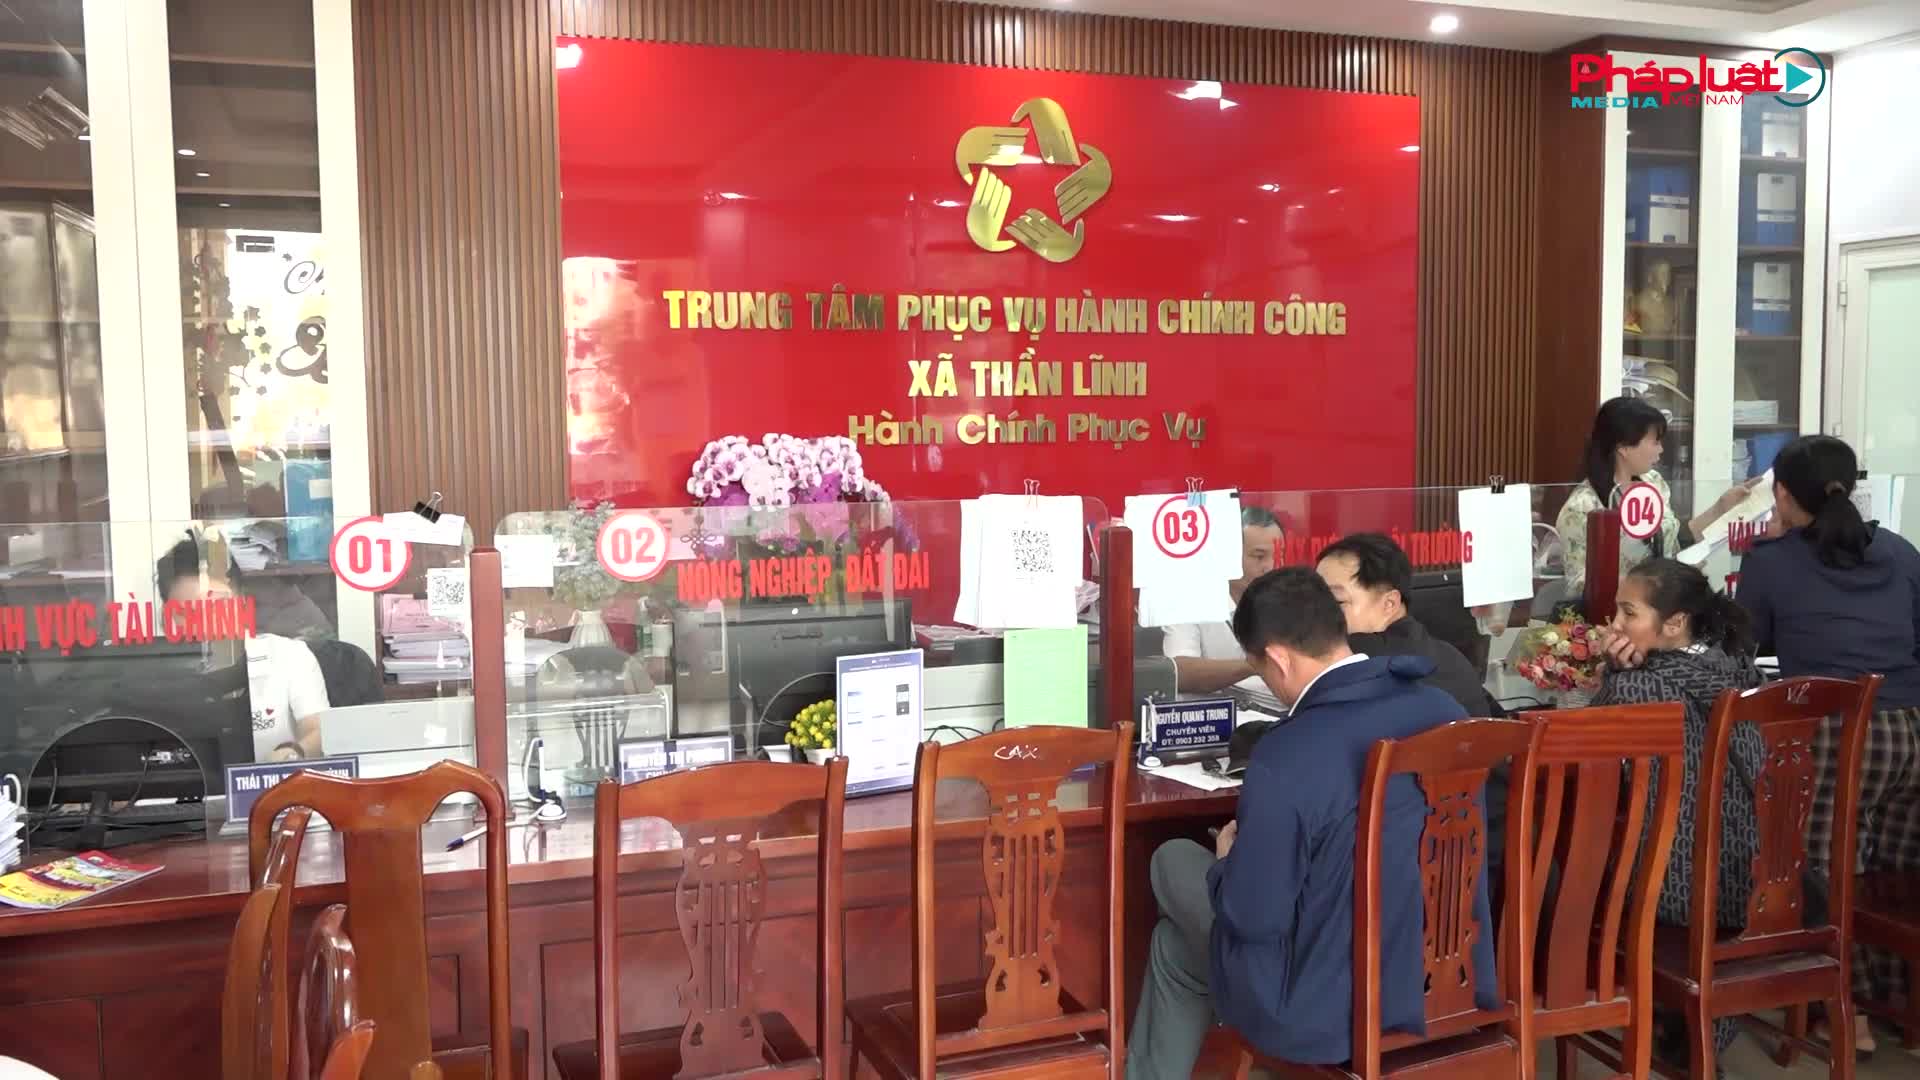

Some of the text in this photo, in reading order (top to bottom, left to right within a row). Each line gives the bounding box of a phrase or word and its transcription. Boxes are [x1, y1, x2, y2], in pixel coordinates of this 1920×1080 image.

[662, 283, 1347, 341] TRUNG TÂM PHỤC VỤ HÀNH CHÍNH CÔNG
[907, 347, 1147, 397] XÃ THẦN LĨNH
[848, 409, 1207, 449] Hành Chính Phục Vụ
[1164, 509, 1198, 544] 03
[1627, 496, 1656, 526] 04
[348, 535, 392, 574] 01
[611, 527, 656, 564] 02
[750, 546, 831, 604] NGHIỆP
[33, 597, 97, 656] VỰC
[107, 592, 154, 646] TÀI
[164, 590, 257, 643] CHÍNH
[1206, 708, 1229, 721] TRUNG
[235, 772, 260, 791] THÁI
